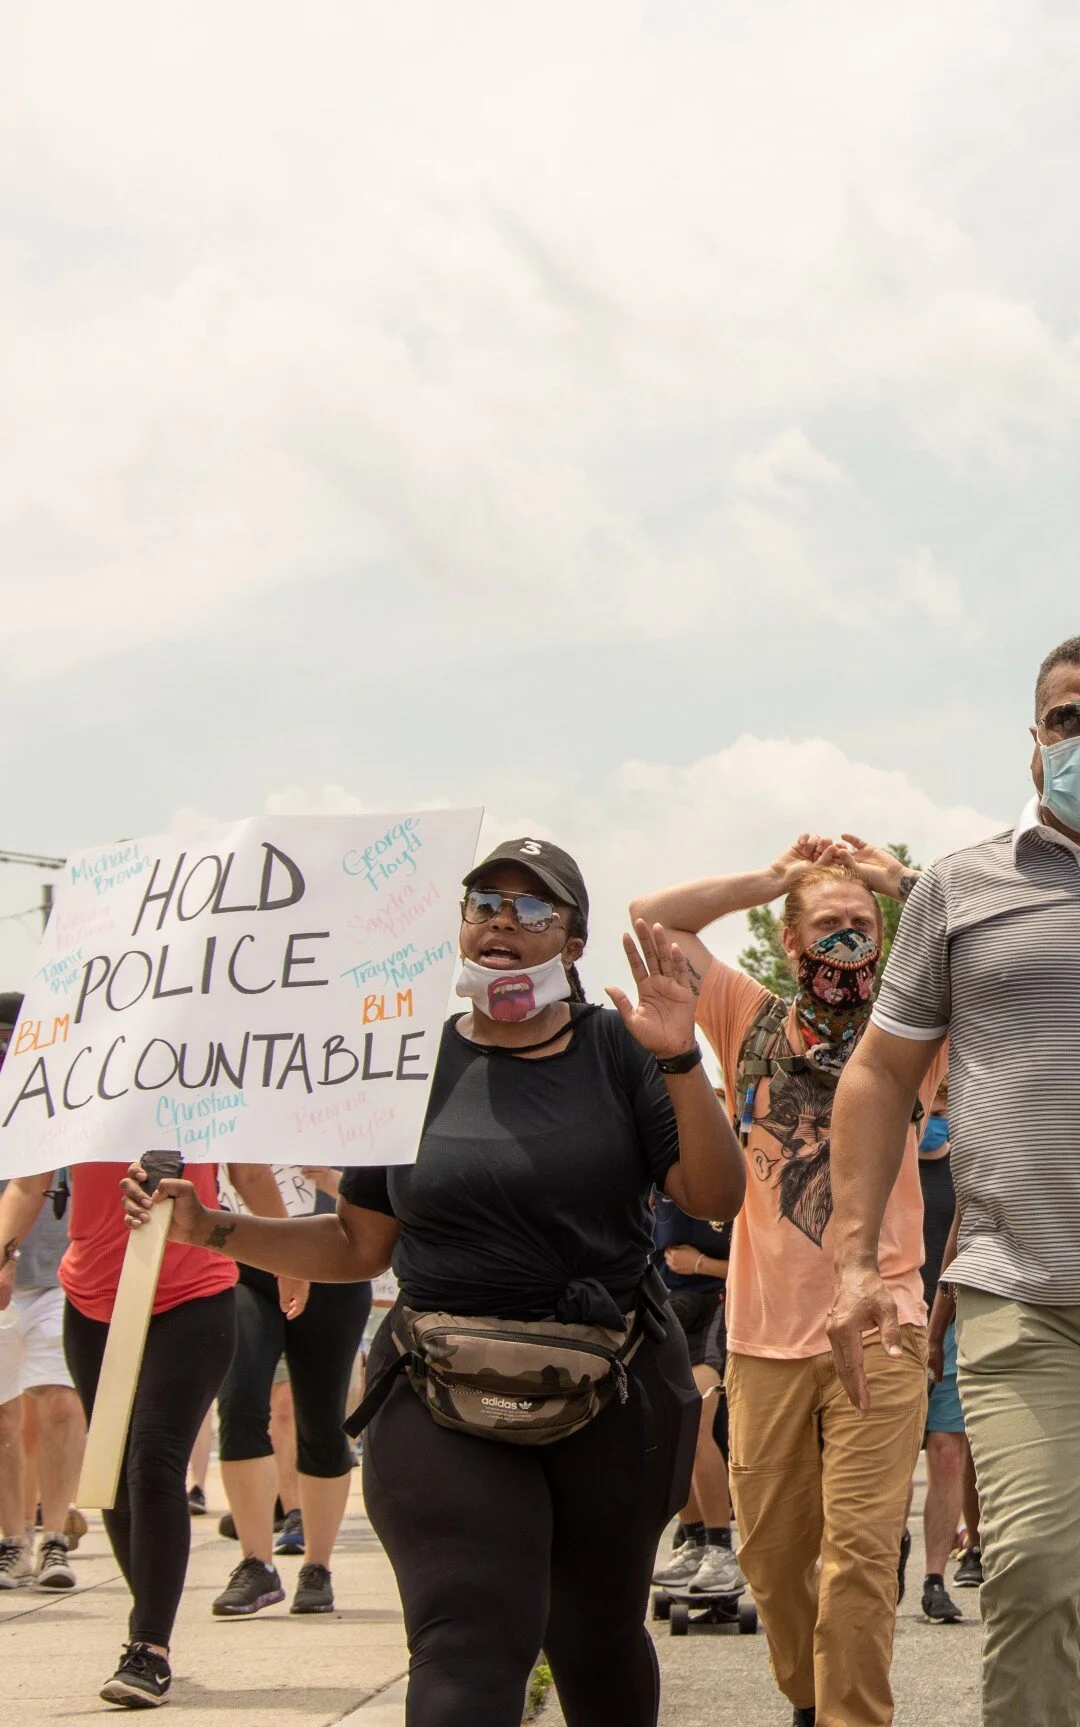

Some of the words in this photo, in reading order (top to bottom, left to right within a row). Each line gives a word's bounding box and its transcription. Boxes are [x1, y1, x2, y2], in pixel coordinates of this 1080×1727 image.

[71, 844, 139, 885] Michael
[343, 818, 421, 875] George
[364, 832, 422, 891] Floyd
[520, 841, 542, 856] 3
[93, 855, 152, 895] Brown
[131, 842, 306, 936] HOLD
[34, 946, 82, 982] Tamir
[74, 931, 330, 1024] POLICE
[340, 943, 417, 987] Trayvon
[391, 941, 453, 988] Martin
[363, 988, 413, 1024] BLM
[14, 1013, 70, 1056] BLM
[2, 1031, 429, 1127] ACCOUNTABLE
[156, 1091, 248, 1129] Christian
[162, 1116, 237, 1158] Taylor
[481, 1397, 517, 1410] adidas
